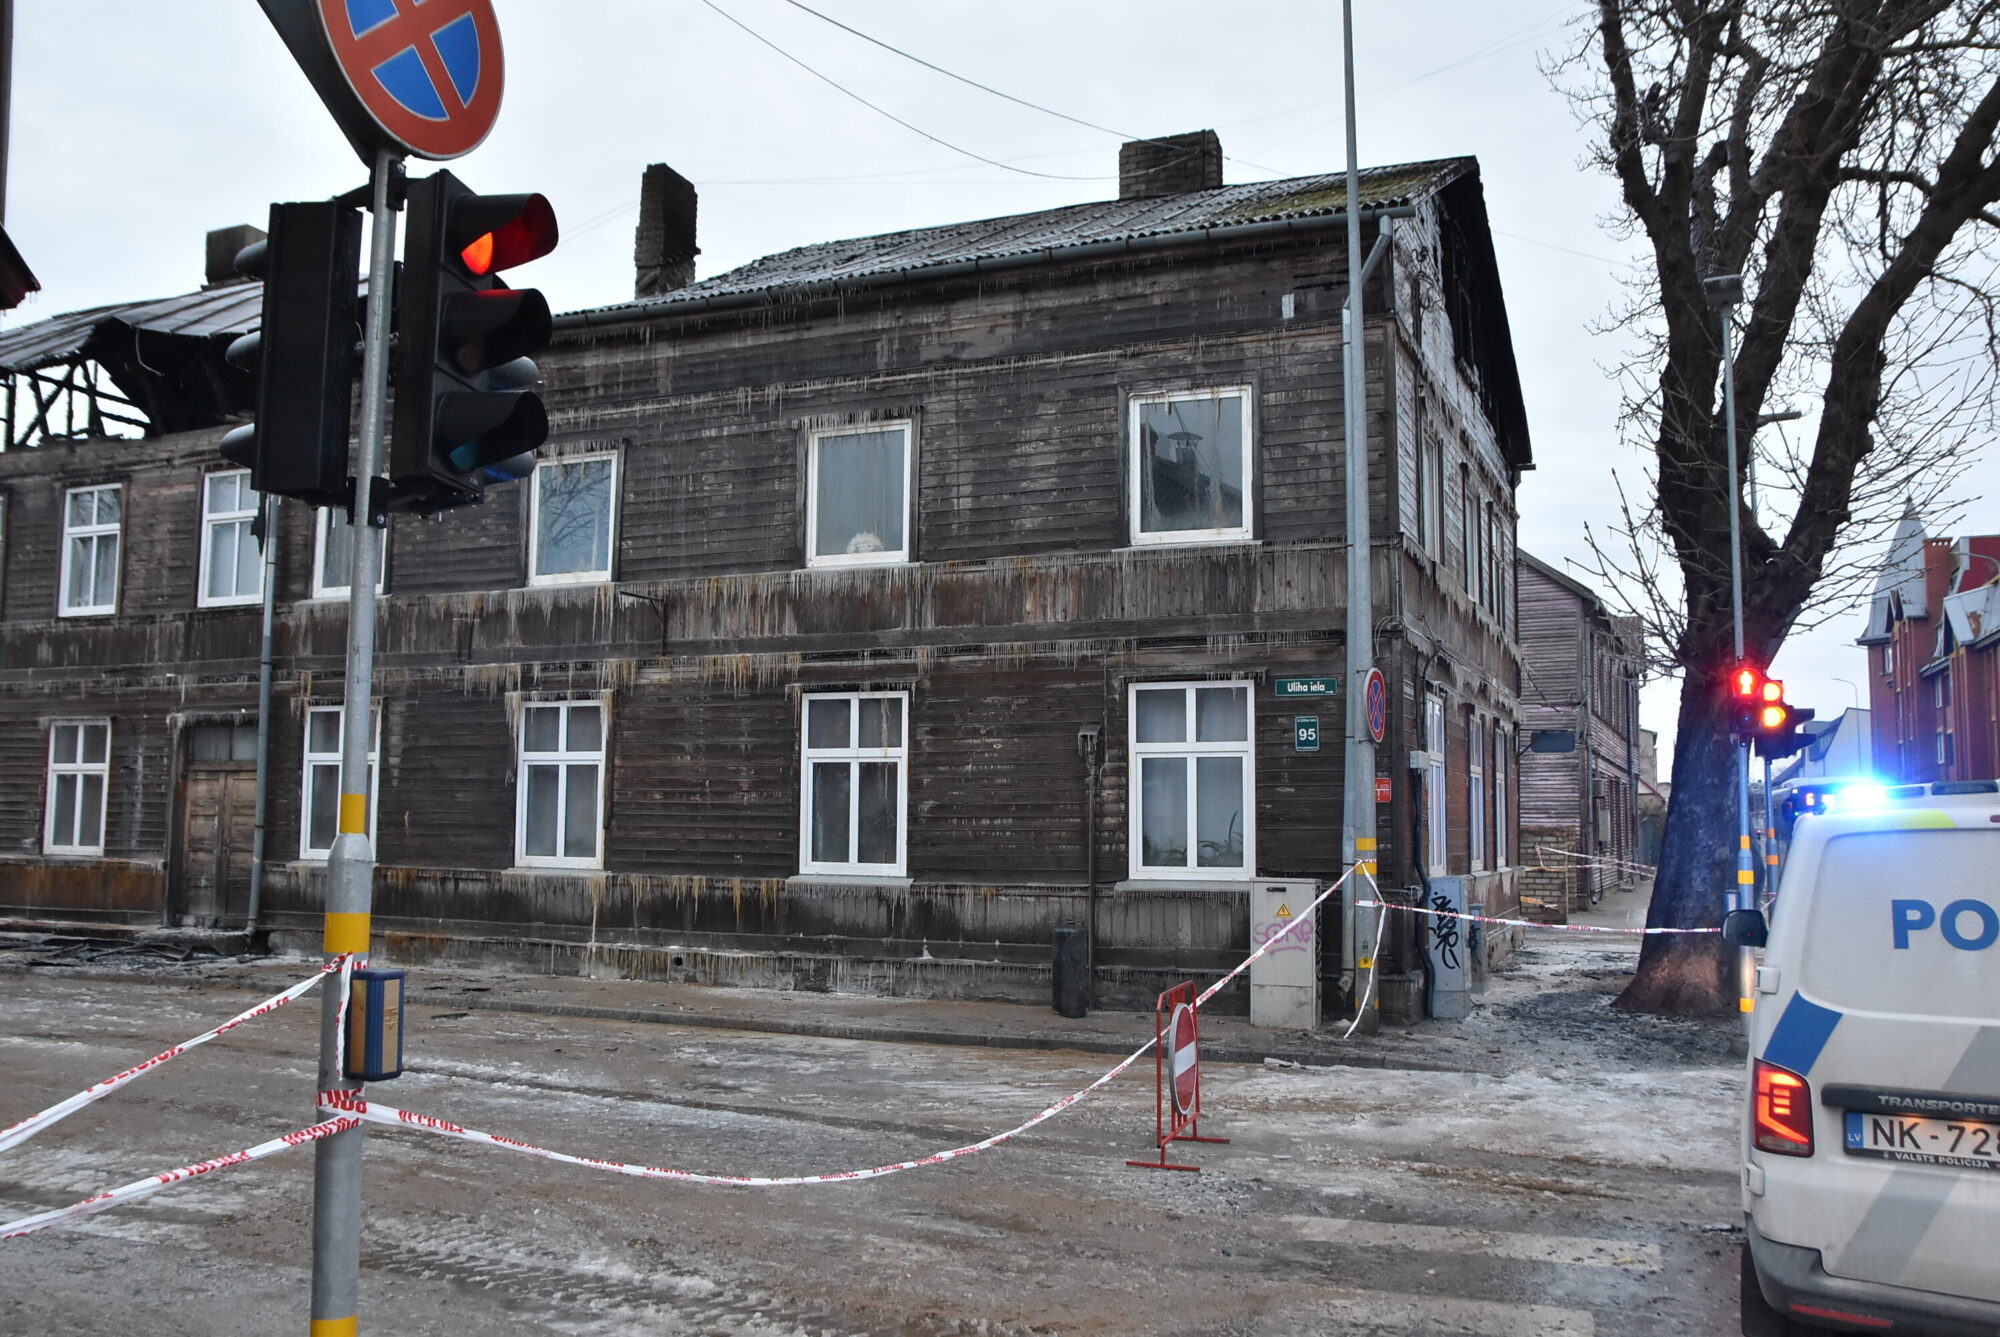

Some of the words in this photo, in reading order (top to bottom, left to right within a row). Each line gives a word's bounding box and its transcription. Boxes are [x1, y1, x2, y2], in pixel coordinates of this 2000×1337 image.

[1287, 681, 1308, 692] Uliha
[1310, 681, 1325, 692] iela
[1298, 728, 1316, 741] 95
[1891, 899, 2000, 951] PO
[1847, 1133, 1861, 1142] LV
[1871, 1118, 2000, 1157] NK-72
[1895, 1152, 1935, 1164] VALSTS
[1938, 1156, 1990, 1169] POLICIJA
